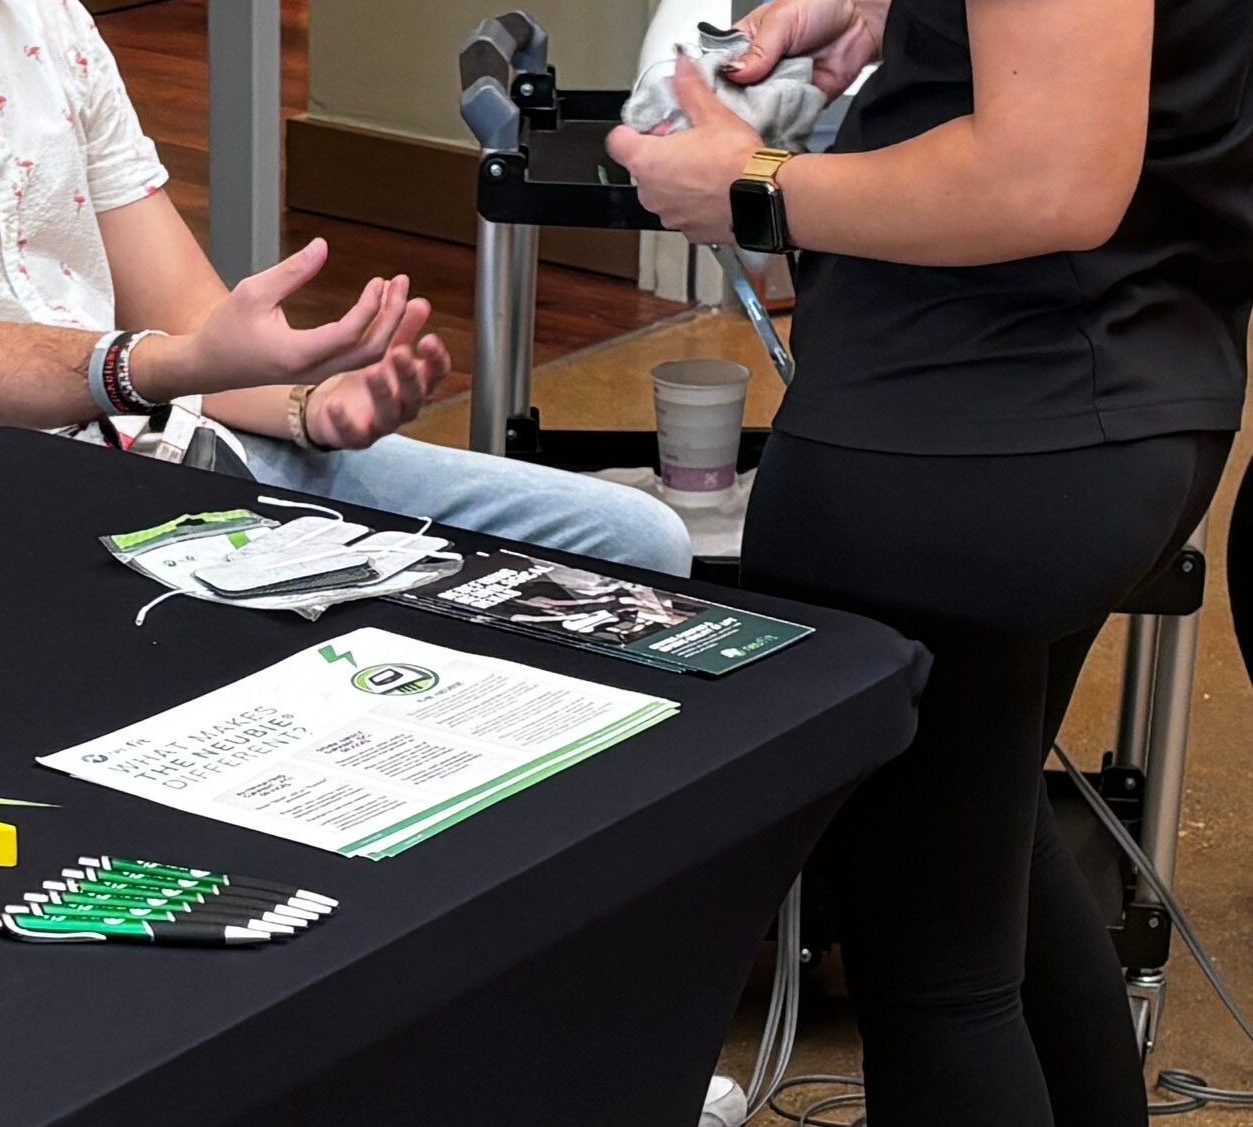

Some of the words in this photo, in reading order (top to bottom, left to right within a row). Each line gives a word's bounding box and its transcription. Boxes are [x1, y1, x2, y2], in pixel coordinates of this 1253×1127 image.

[107, 741, 188, 775] WHAT
[188, 705, 277, 743] MAKES
[134, 755, 196, 781] THE
[162, 727, 313, 790] DIFFERENT?
